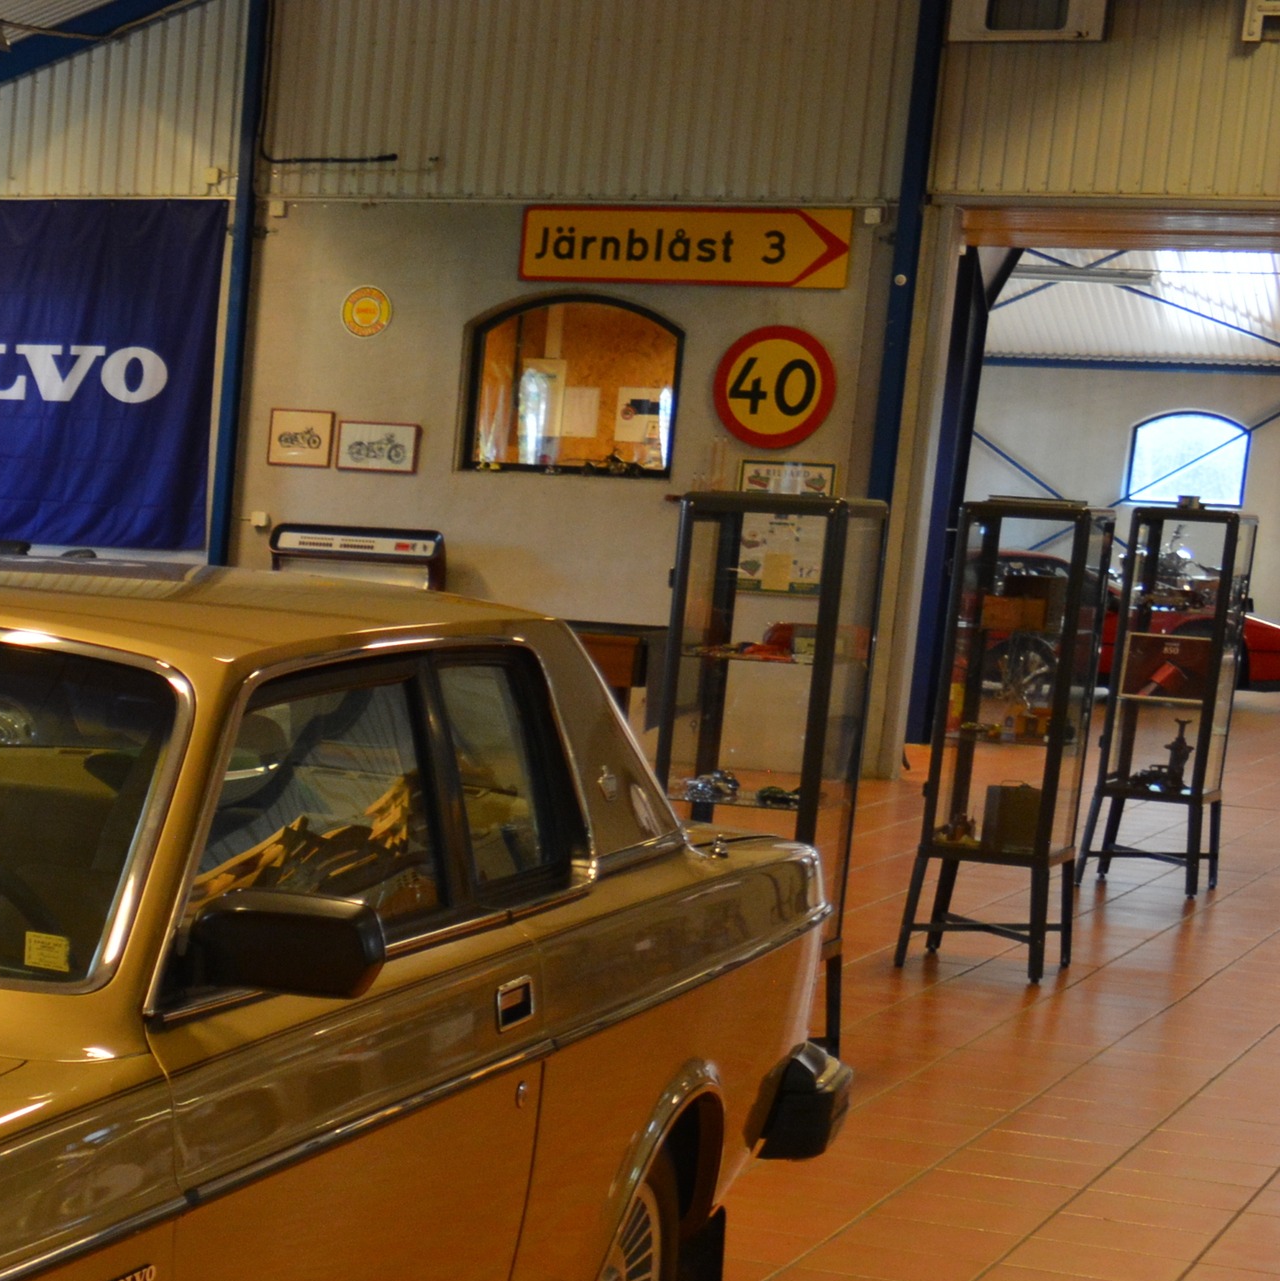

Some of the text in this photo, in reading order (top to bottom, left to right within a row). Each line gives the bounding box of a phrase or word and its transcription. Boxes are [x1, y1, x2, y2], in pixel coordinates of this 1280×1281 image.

[534, 226, 786, 265] Järnblåst 3
[728, 356, 817, 417] 40
